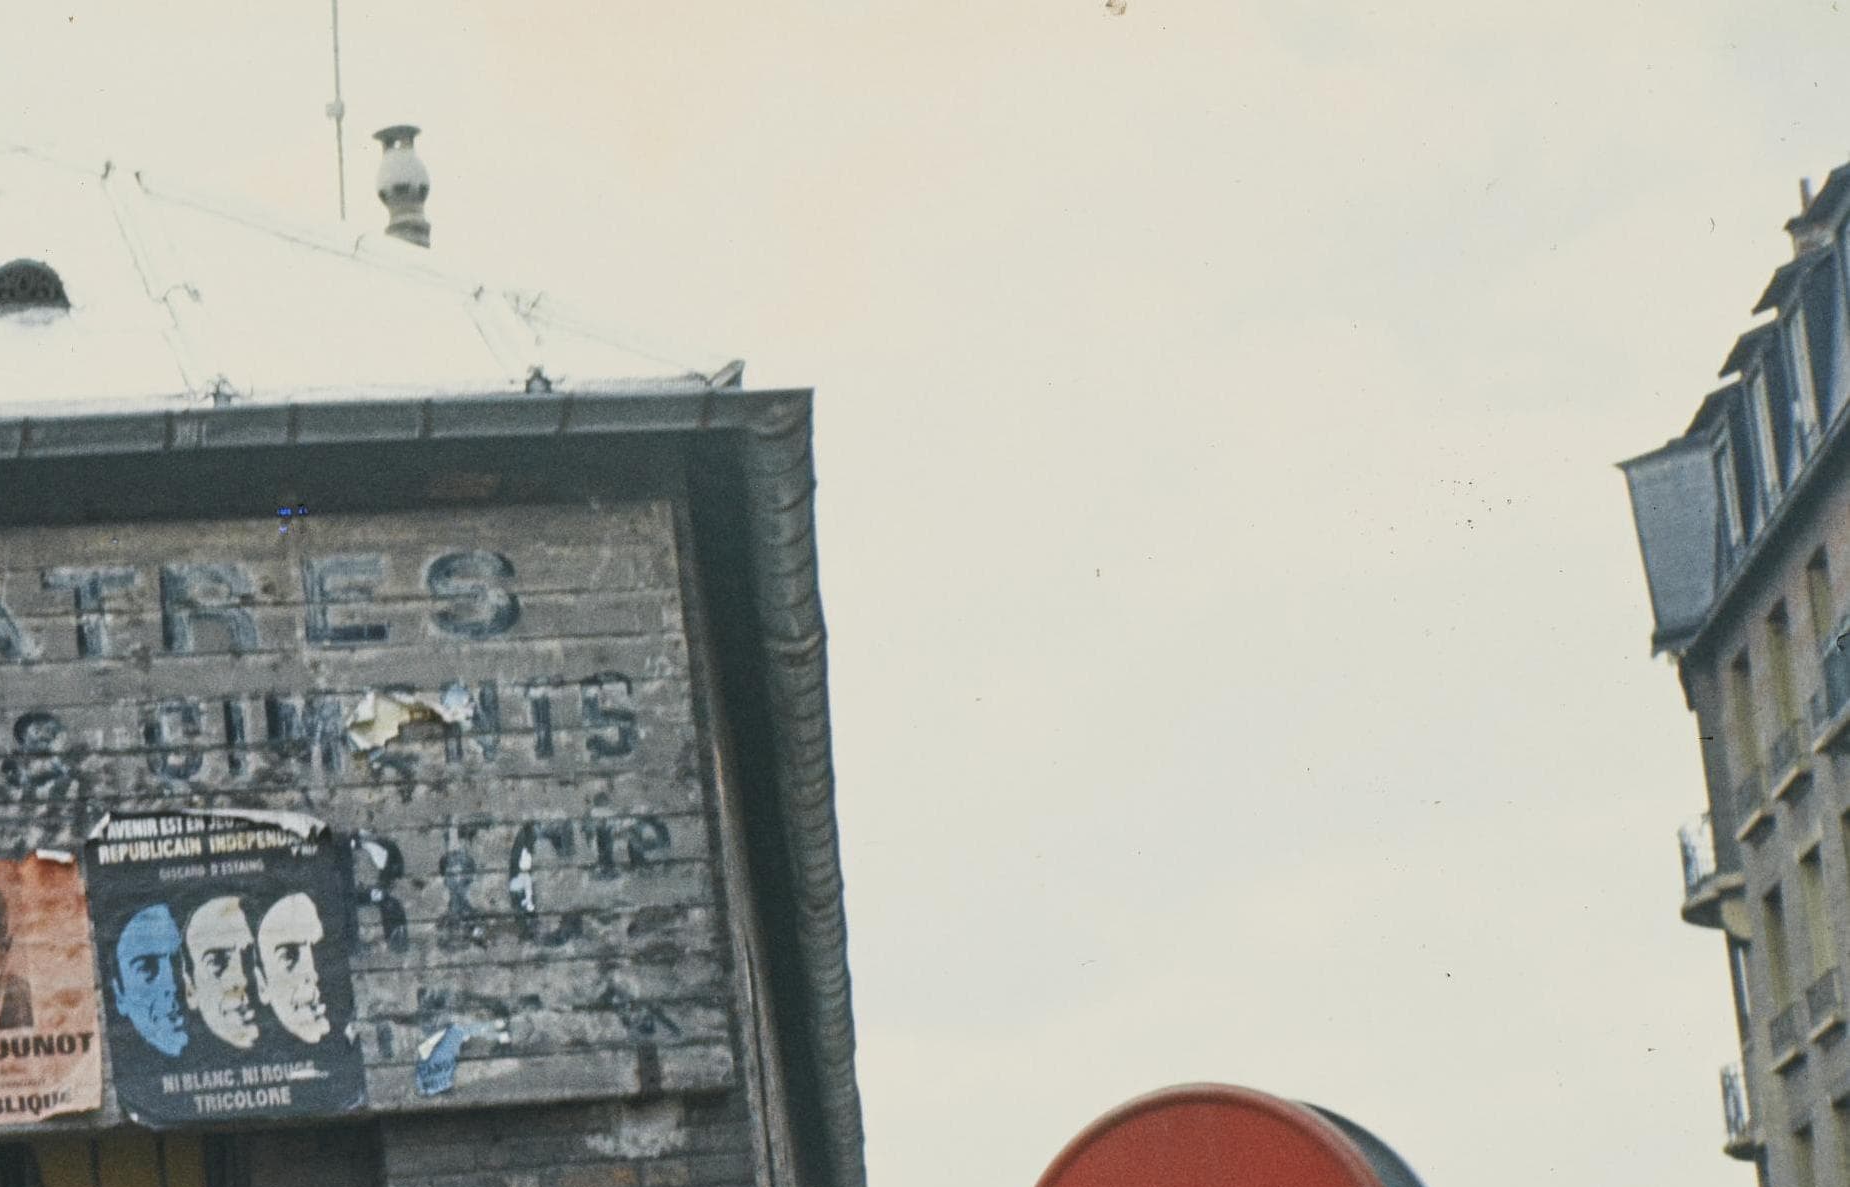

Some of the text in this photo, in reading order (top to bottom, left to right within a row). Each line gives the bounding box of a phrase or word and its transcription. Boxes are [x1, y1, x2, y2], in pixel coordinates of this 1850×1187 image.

[160, 815, 183, 835] EST
[186, 815, 205, 833] EN
[98, 837, 202, 866] REPUBLICAIN
[162, 1073, 180, 1094] NI
[242, 1066, 259, 1085] NI
[193, 1085, 292, 1114] TRICOLORE
